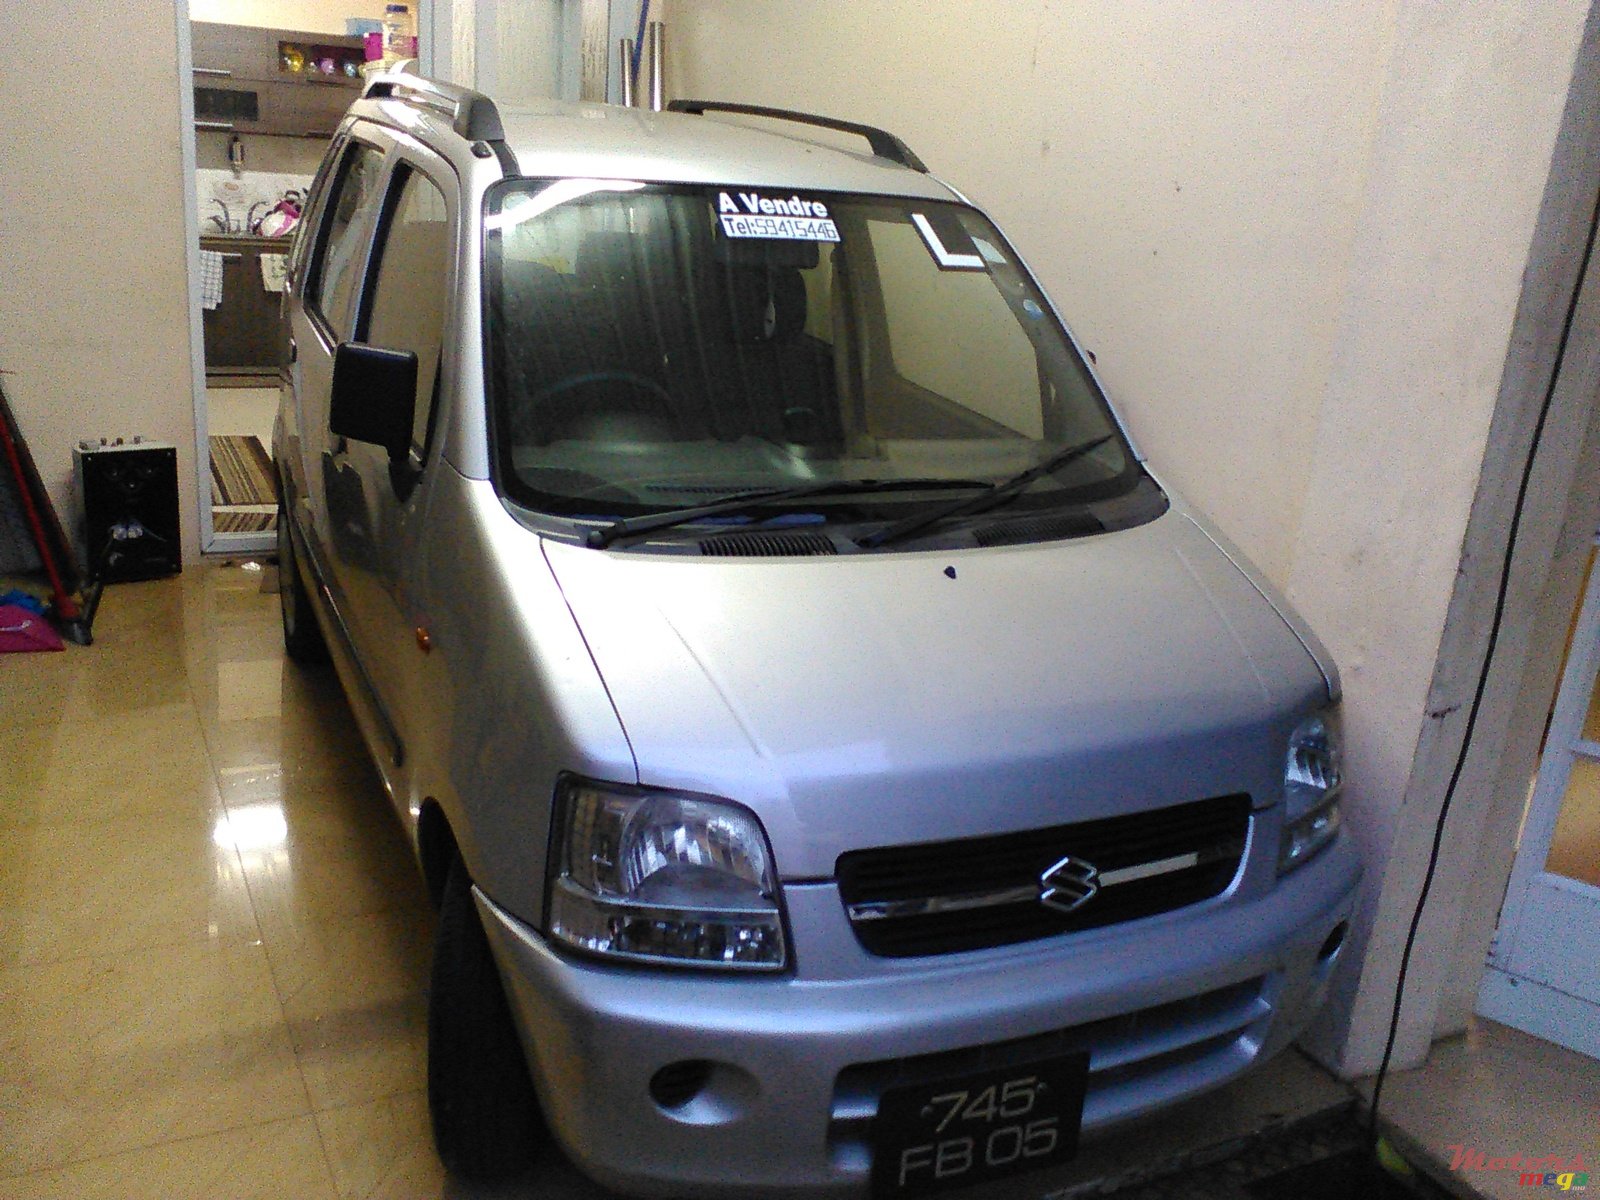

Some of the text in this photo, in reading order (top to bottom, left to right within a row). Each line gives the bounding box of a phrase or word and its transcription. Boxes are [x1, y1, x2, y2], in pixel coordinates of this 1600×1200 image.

[719, 192, 828, 217] A Vendre
[911, 213, 985, 268] L
[931, 1076, 1037, 1133] 745
[900, 1117, 1059, 1186] FB 05
